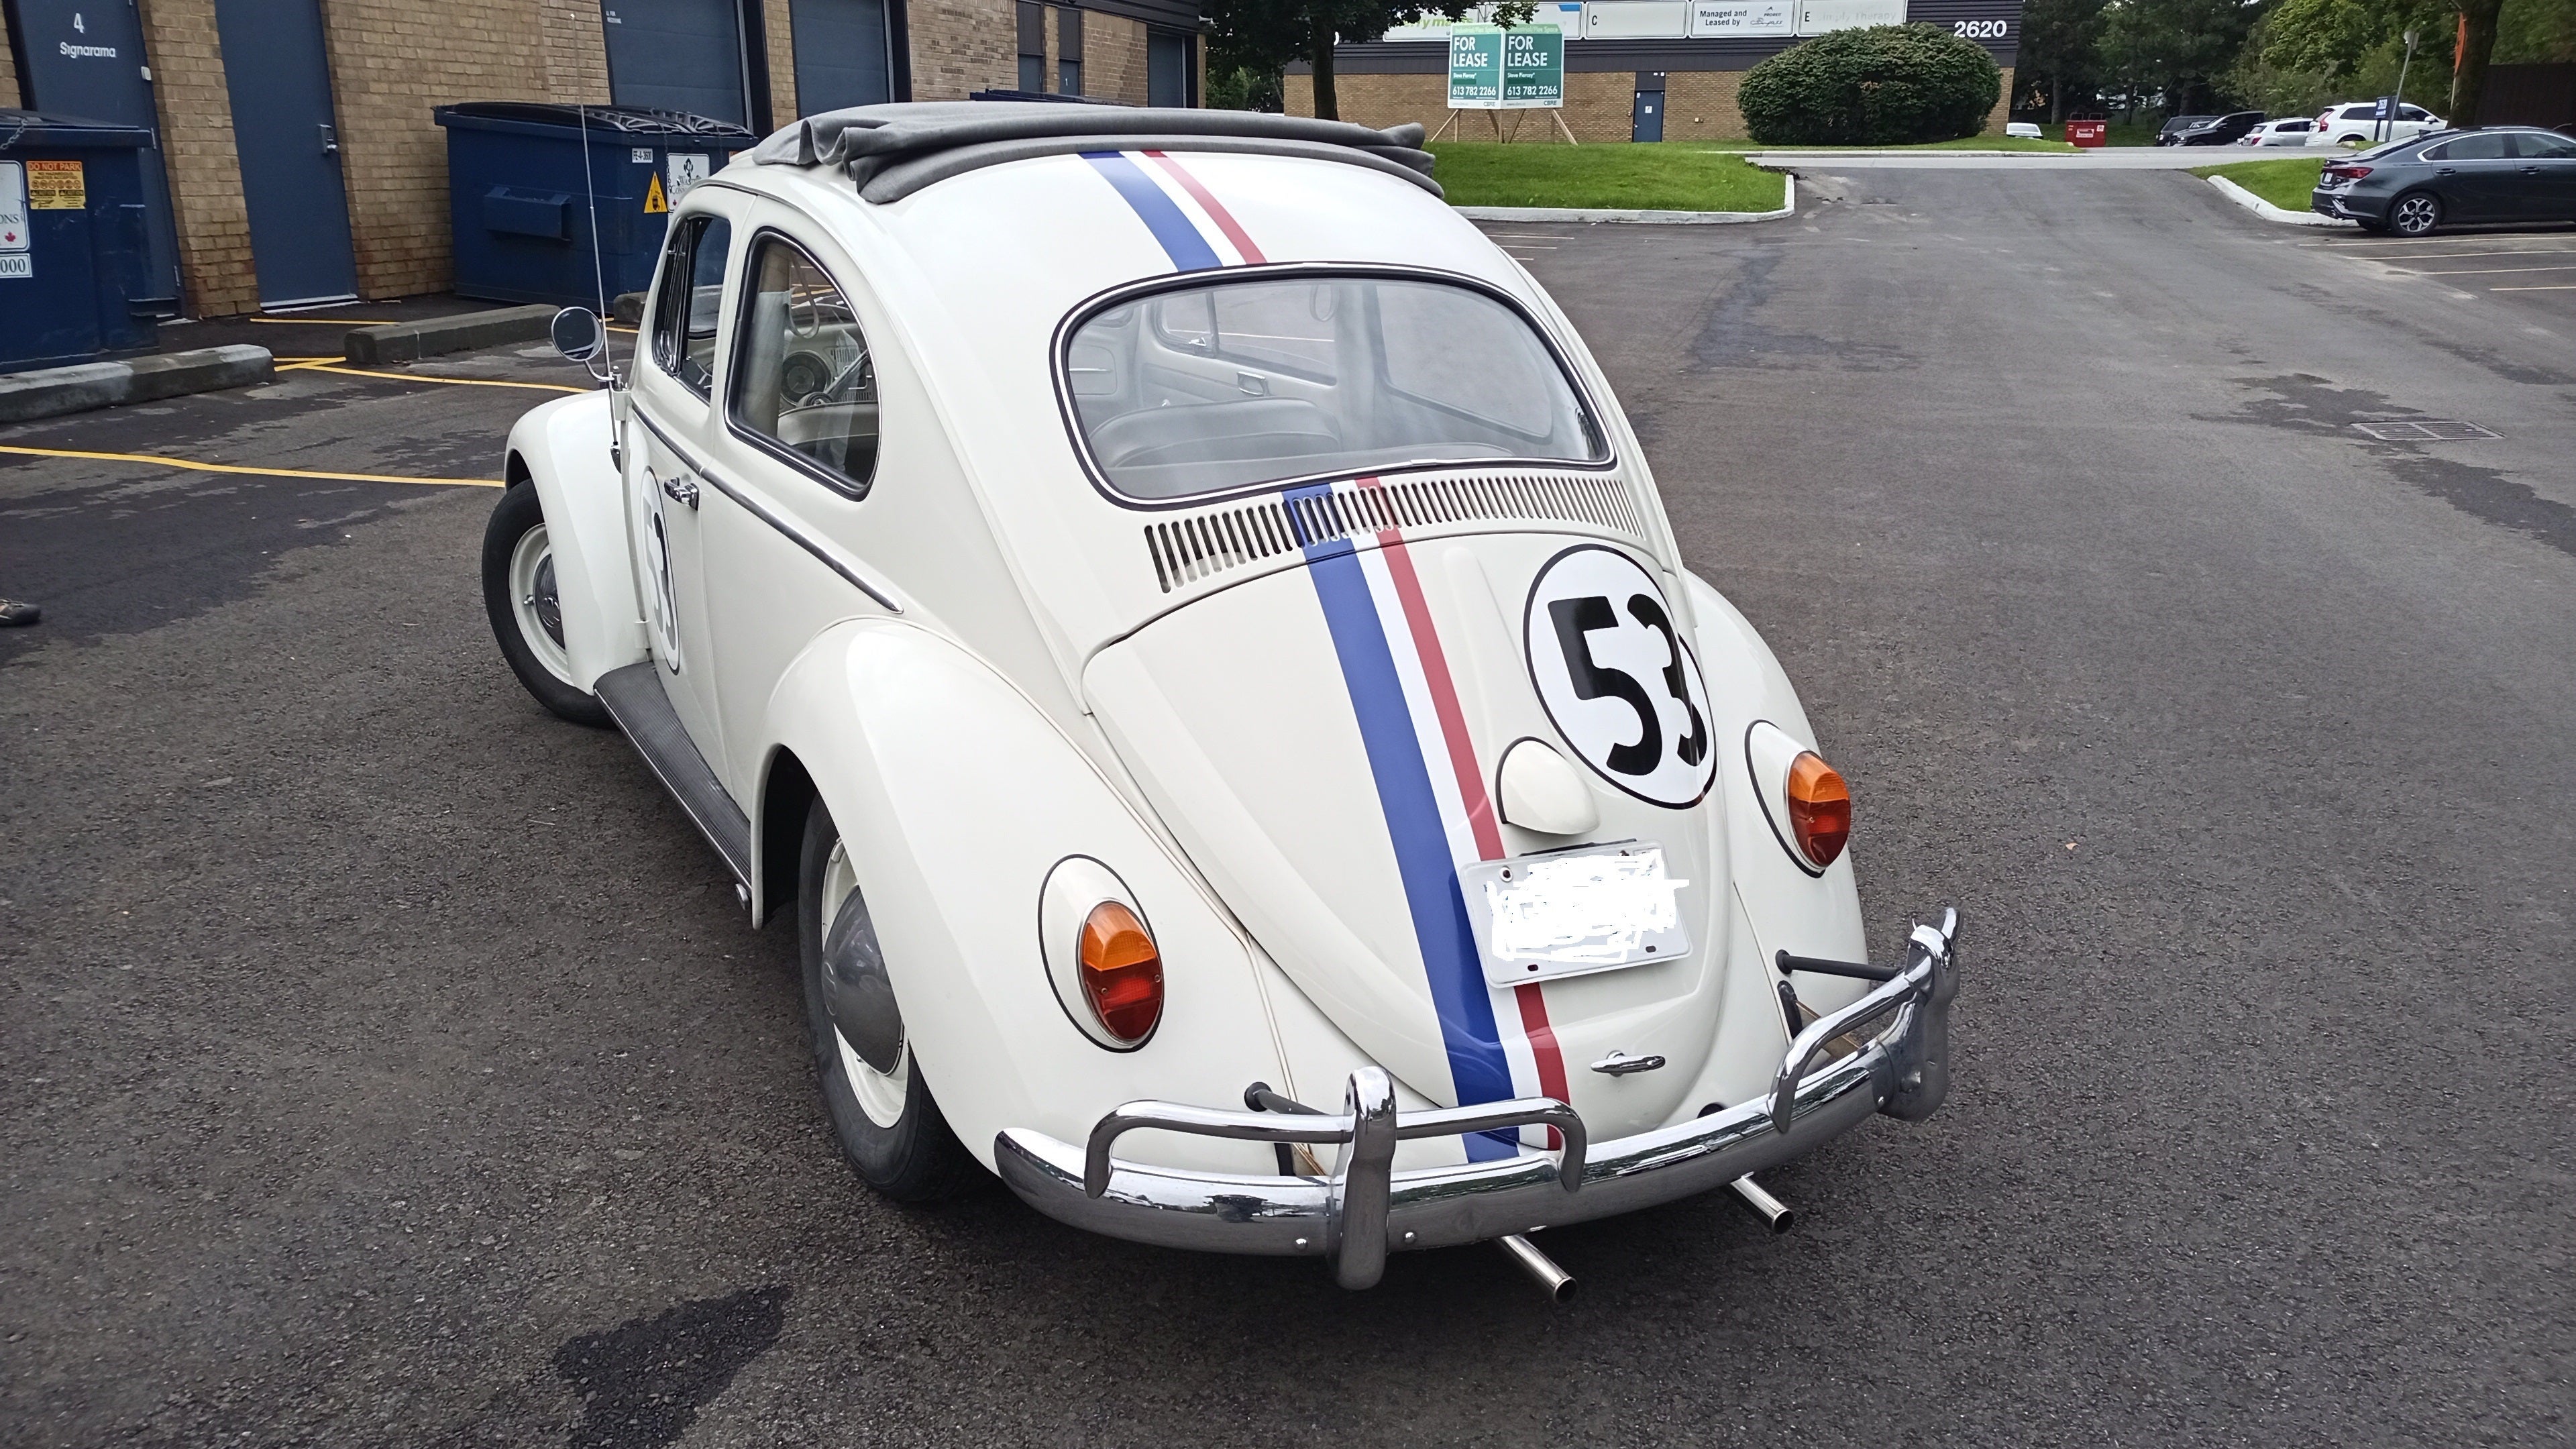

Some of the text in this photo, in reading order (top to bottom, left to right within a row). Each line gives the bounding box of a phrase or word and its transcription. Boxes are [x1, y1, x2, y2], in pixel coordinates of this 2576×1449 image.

[1591, 15, 1597, 25] C
[1699, 10, 1732, 19] Managed
[1805, 11, 1811, 22] E
[74, 13, 85, 34] 4
[1705, 17, 1741, 27] Leased by
[1953, 19, 2007, 38] 2620
[60, 41, 117, 59] Signarama
[1454, 36, 1476, 52] FOR
[1508, 36, 1534, 50] FOR
[1453, 52, 1488, 67] LEASE
[1507, 52, 1548, 67] LEASE
[1452, 86, 1497, 96] 613 782 2266
[1507, 85, 1558, 95] 613 782 2266
[1547, 593, 1708, 777] 53
